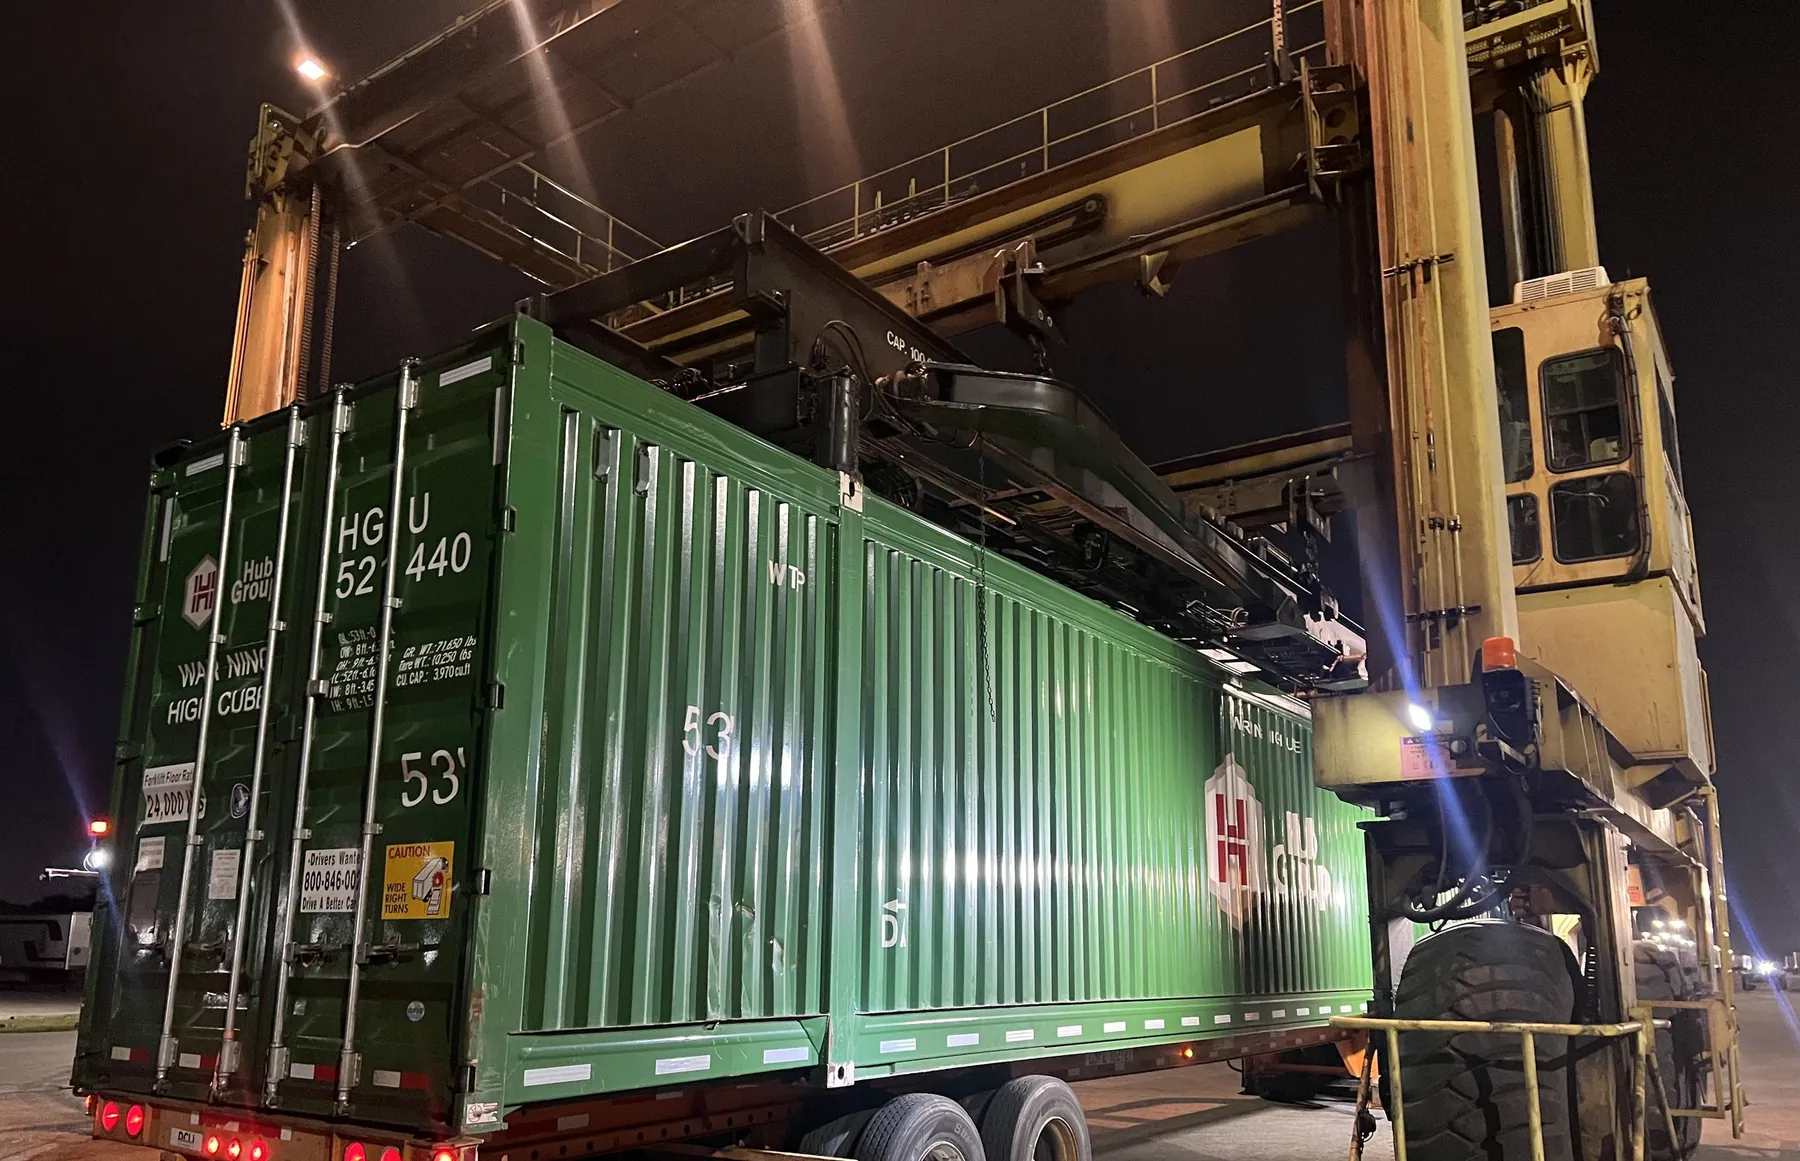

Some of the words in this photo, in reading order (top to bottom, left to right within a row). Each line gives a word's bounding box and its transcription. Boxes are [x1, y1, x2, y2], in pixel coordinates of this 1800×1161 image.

[887, 330, 907, 355] CAP.
[910, 347, 933, 364] 100
[338, 492, 430, 554] HGU
[243, 555, 273, 582] Hub
[335, 532, 472, 599] 52440
[464, 635, 477, 647] lbs
[459, 649, 472, 660] lbs
[396, 674, 408, 686] CU.
[144, 772, 166, 787] Forklift
[166, 771, 182, 783] Floor
[401, 746, 466, 807] 53'
[147, 791, 184, 820] 24,000
[339, 850, 361, 865] Wante
[388, 845, 431, 858] CAUTION
[387, 882, 406, 892] WIDE
[302, 896, 317, 910] Drive
[319, 896, 324, 909] A
[326, 896, 344, 910] Better
[385, 893, 407, 903] RIGHT
[385, 903, 408, 914] TURNS
